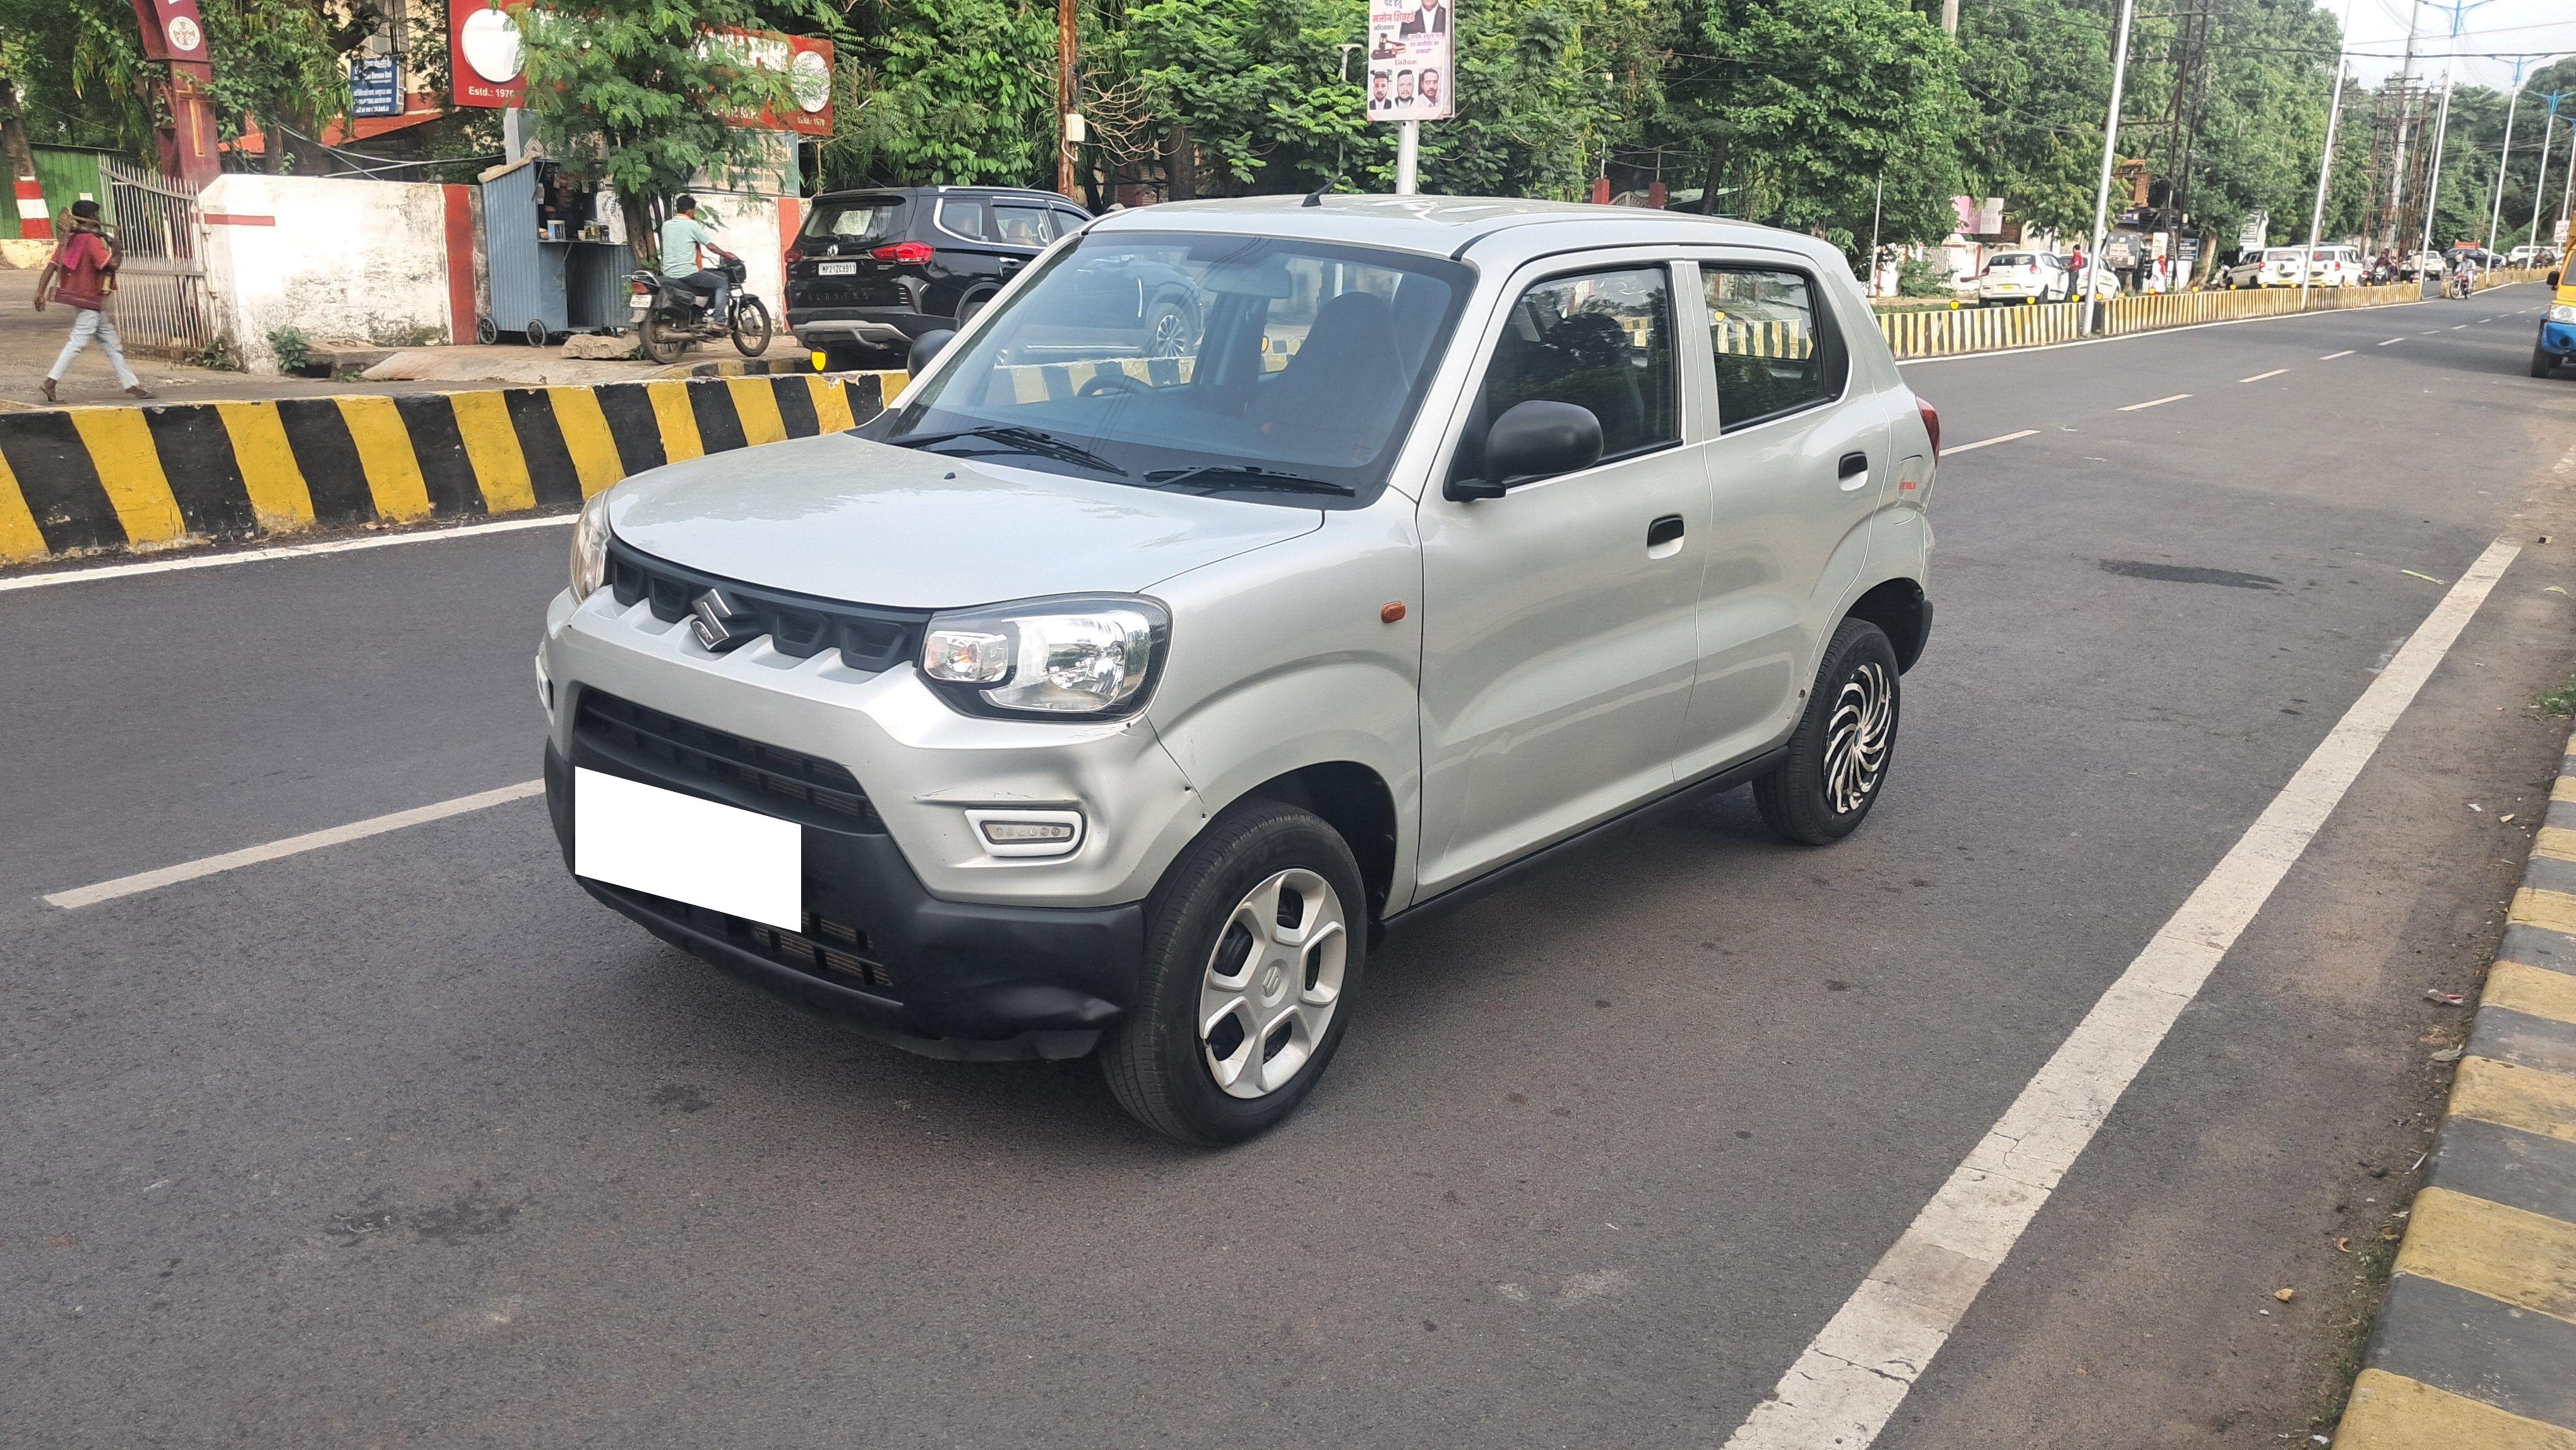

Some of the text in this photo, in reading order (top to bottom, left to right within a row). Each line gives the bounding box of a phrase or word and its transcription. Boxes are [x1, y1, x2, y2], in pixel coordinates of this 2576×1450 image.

[1373, 13, 1392, 23] मनोज
[468, 86, 515, 98] Estd.: 1970
